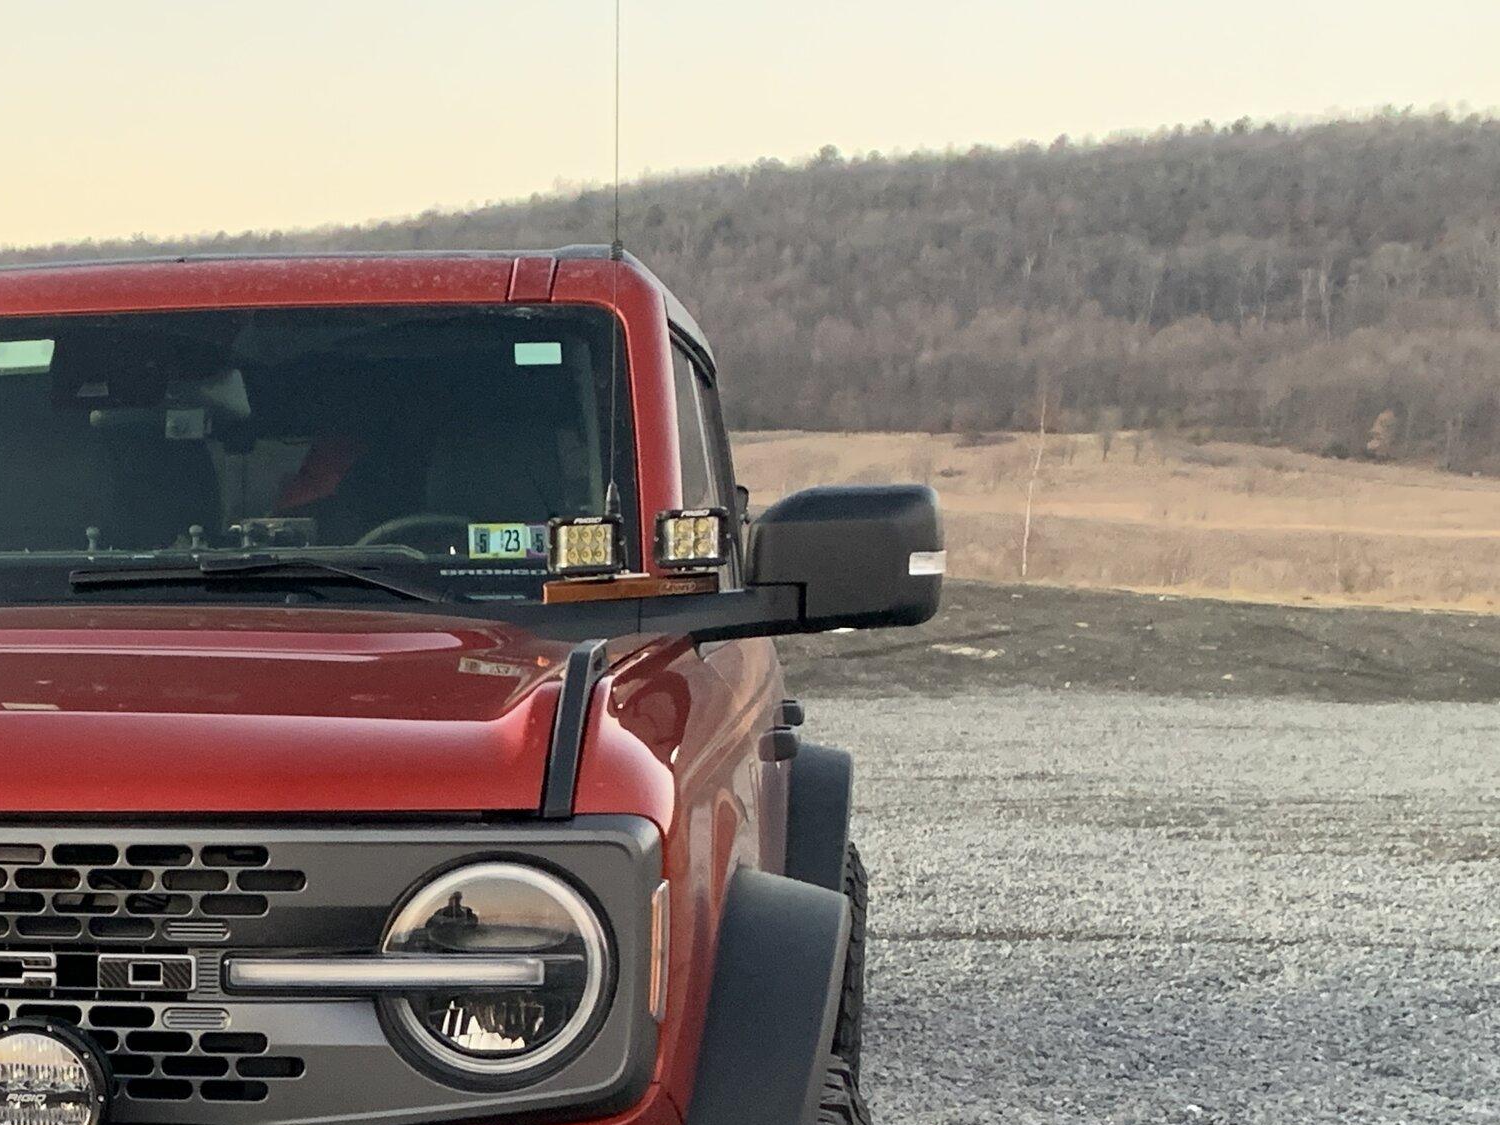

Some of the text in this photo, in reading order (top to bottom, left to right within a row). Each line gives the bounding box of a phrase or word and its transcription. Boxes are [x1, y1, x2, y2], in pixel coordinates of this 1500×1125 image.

[480, 533, 487, 553] 5
[504, 529, 520, 552] 23
[535, 533, 544, 553] 5
